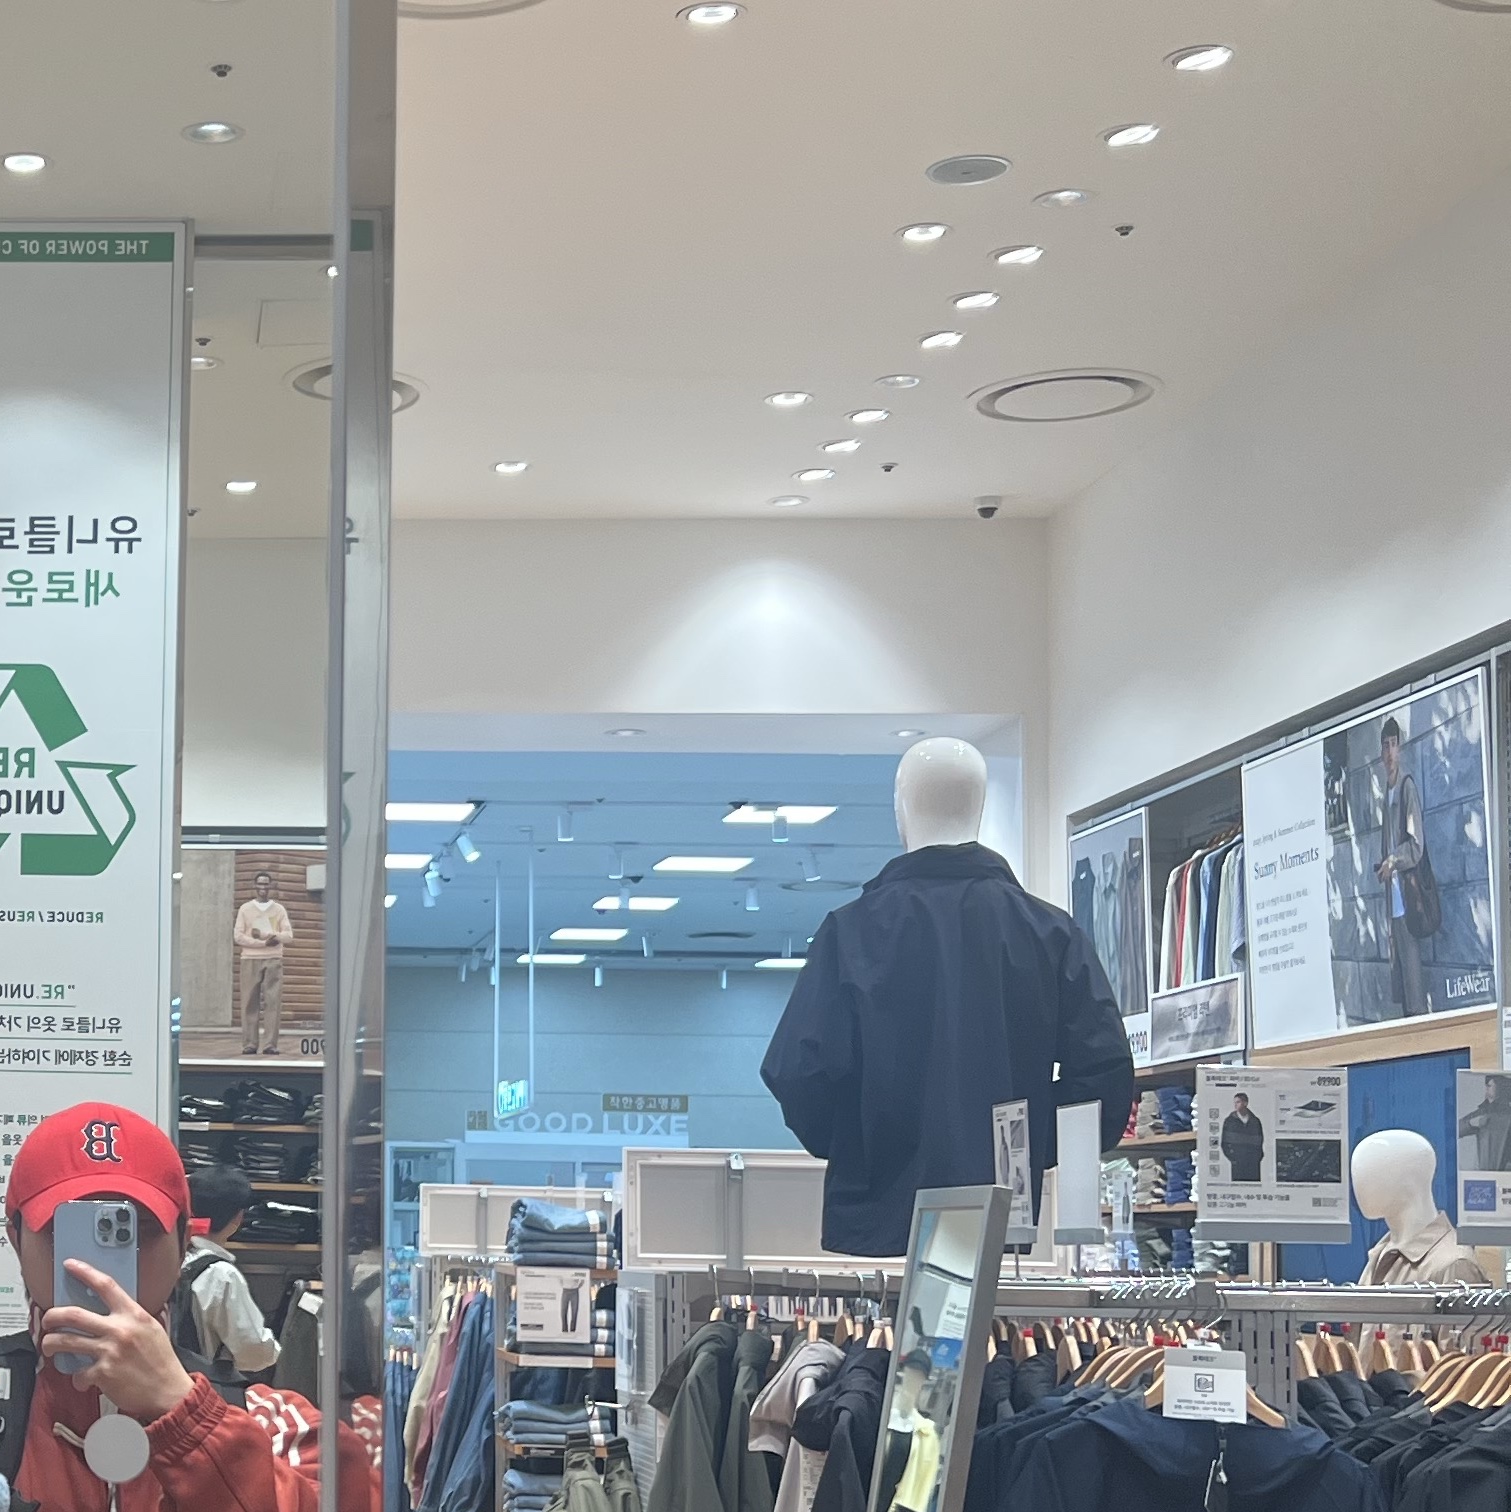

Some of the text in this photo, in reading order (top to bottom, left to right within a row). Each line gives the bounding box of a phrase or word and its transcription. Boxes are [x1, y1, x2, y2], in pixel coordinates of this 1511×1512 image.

[1253, 847, 1319, 880] Sunny Moments
[1446, 973, 1490, 998] LifeWear
[493, 1112, 593, 1133] GOOD
[602, 1113, 689, 1136] LUXE
